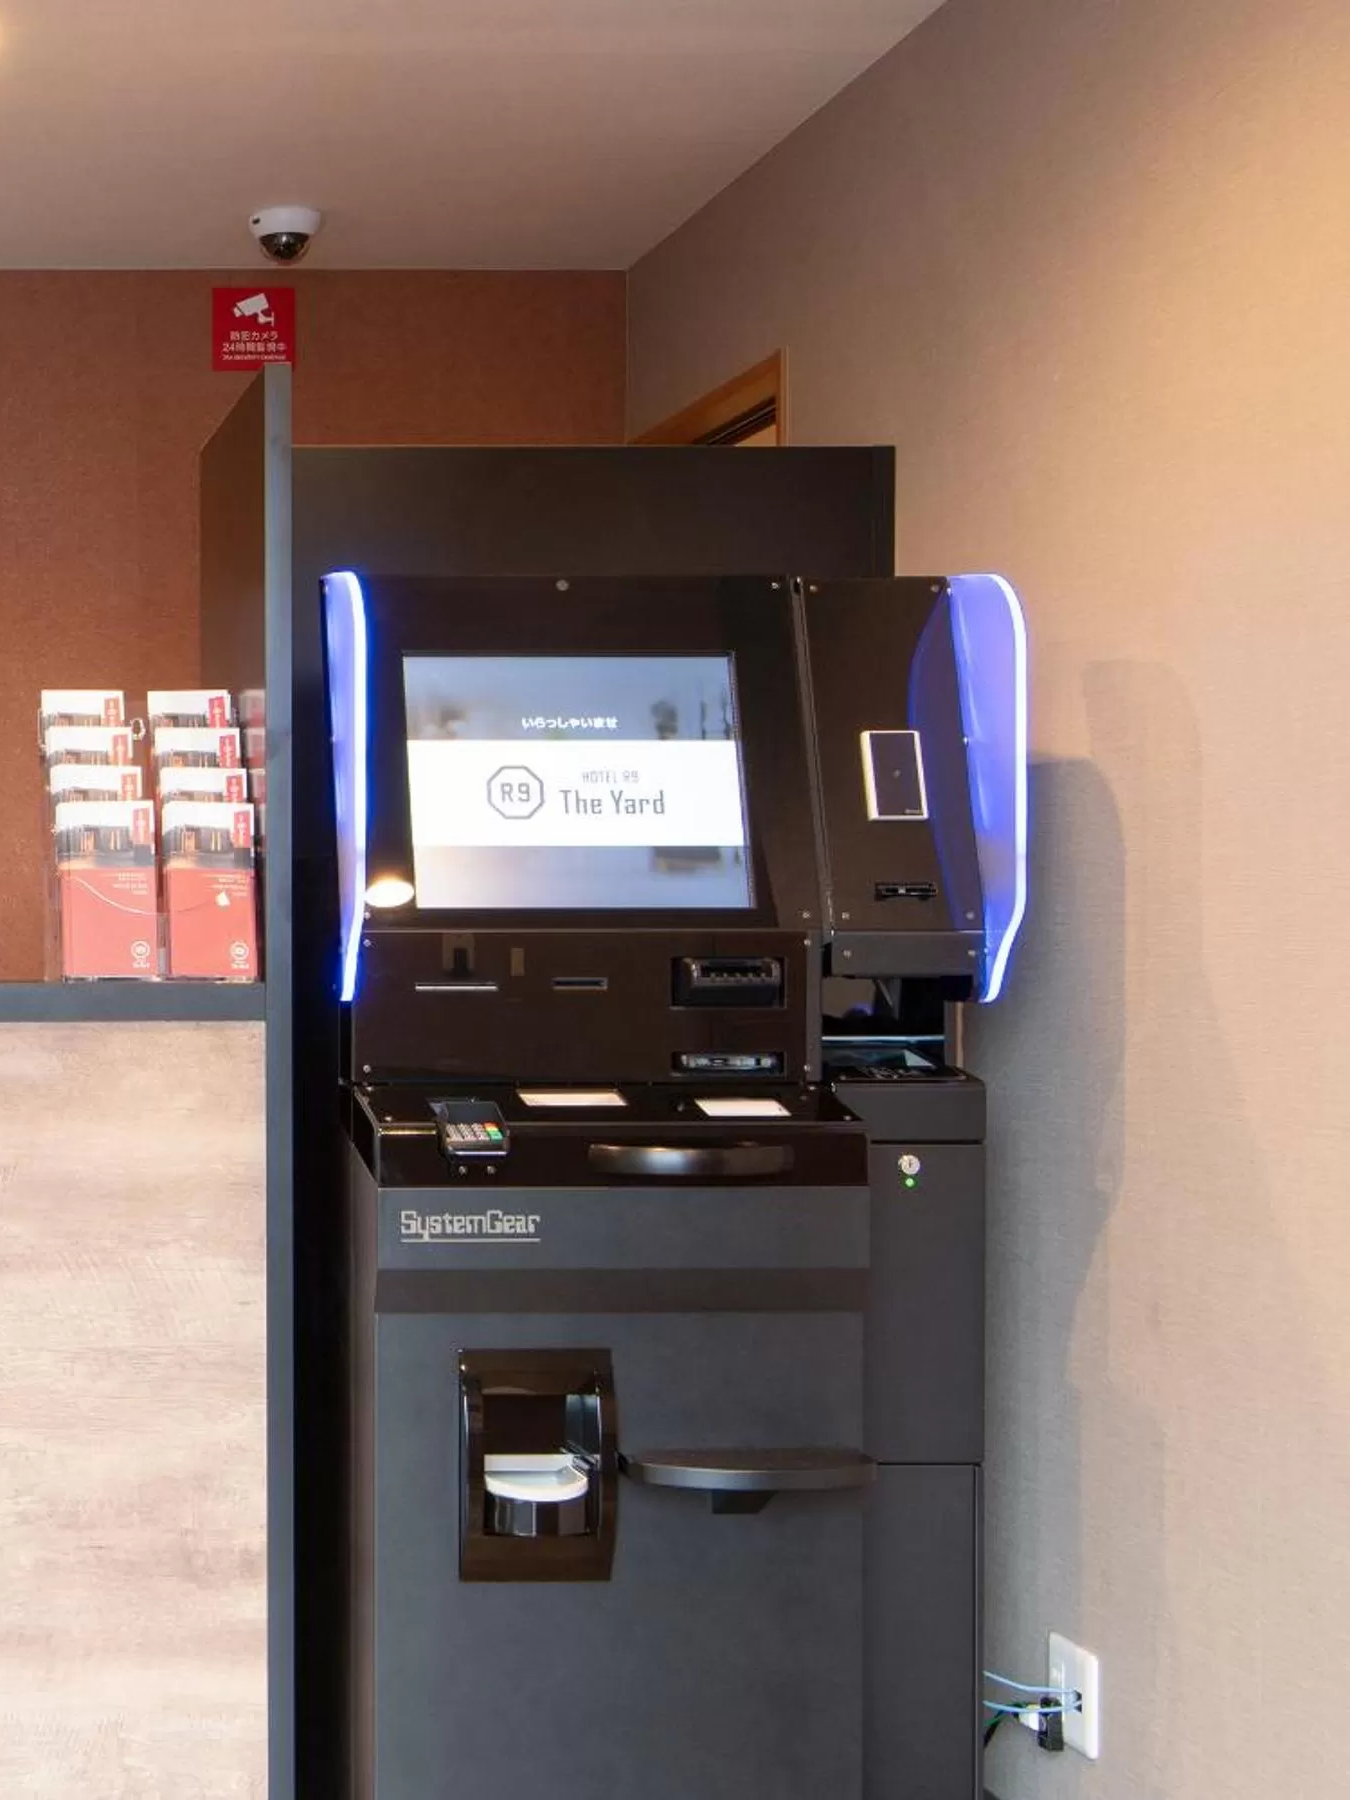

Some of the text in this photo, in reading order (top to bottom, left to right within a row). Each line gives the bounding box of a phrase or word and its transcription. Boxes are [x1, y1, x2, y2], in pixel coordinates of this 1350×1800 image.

[582, 770, 618, 784] HOTEL
[500, 782, 531, 803] R9
[559, 789, 666, 815] The Yard
[400, 1209, 541, 1241] SystemGear
